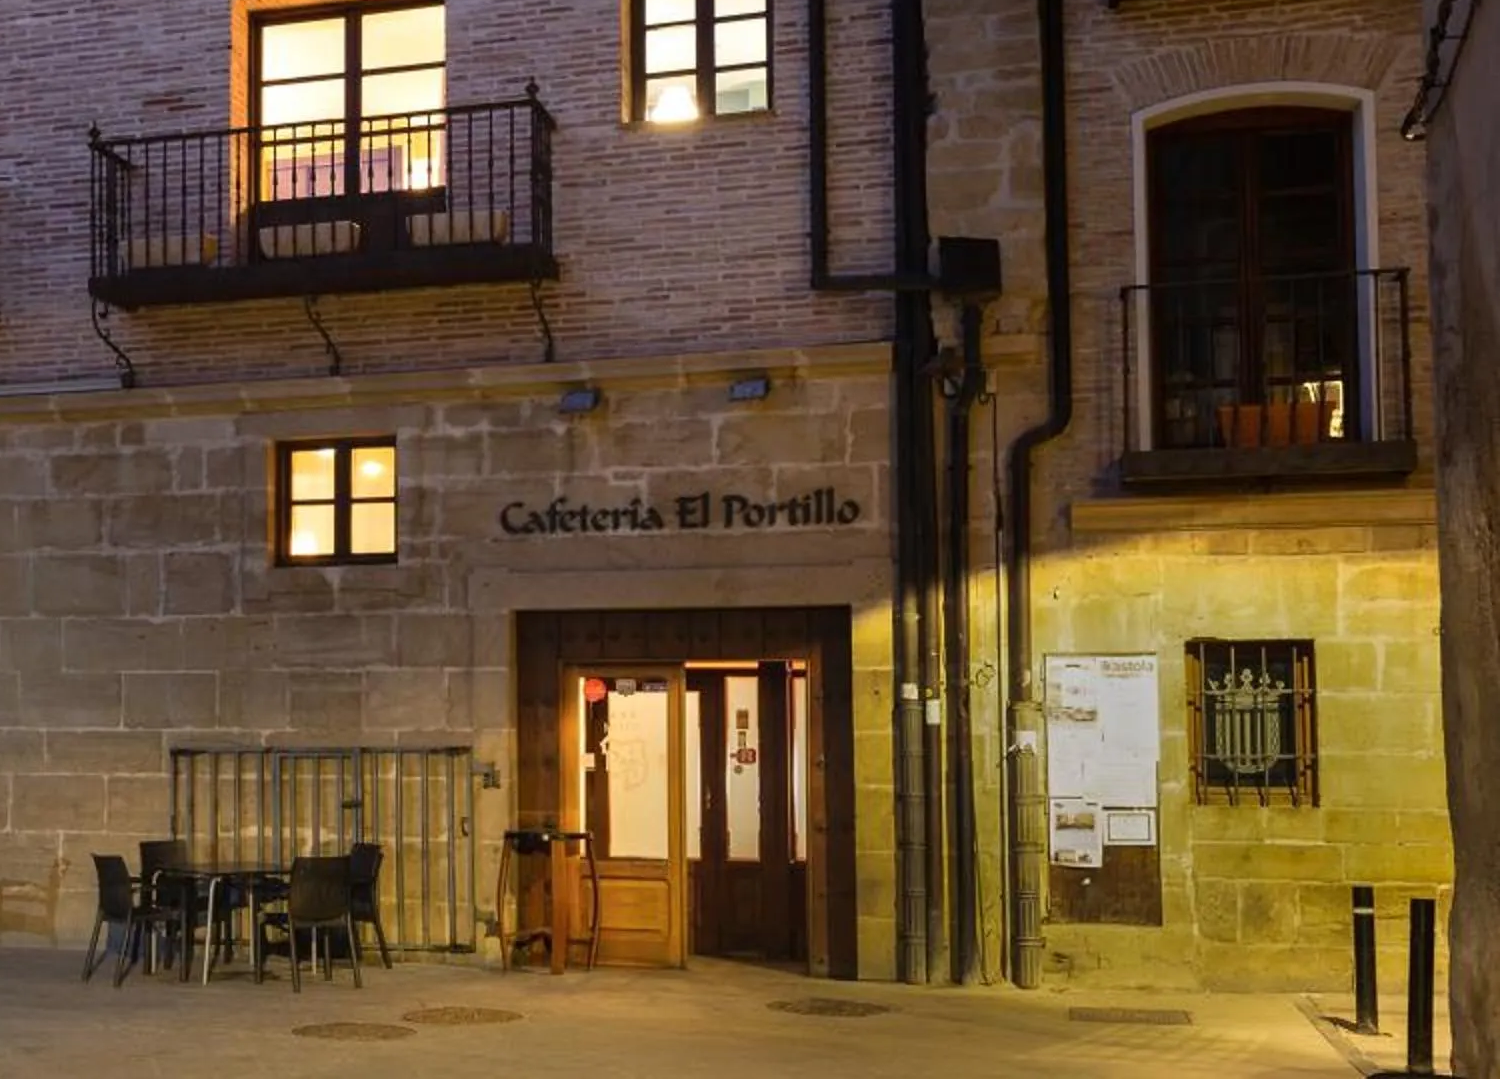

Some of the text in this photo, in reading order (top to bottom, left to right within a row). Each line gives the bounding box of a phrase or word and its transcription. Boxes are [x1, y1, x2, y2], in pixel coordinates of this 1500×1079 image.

[500, 486, 861, 535] Cafetería El Portillo
